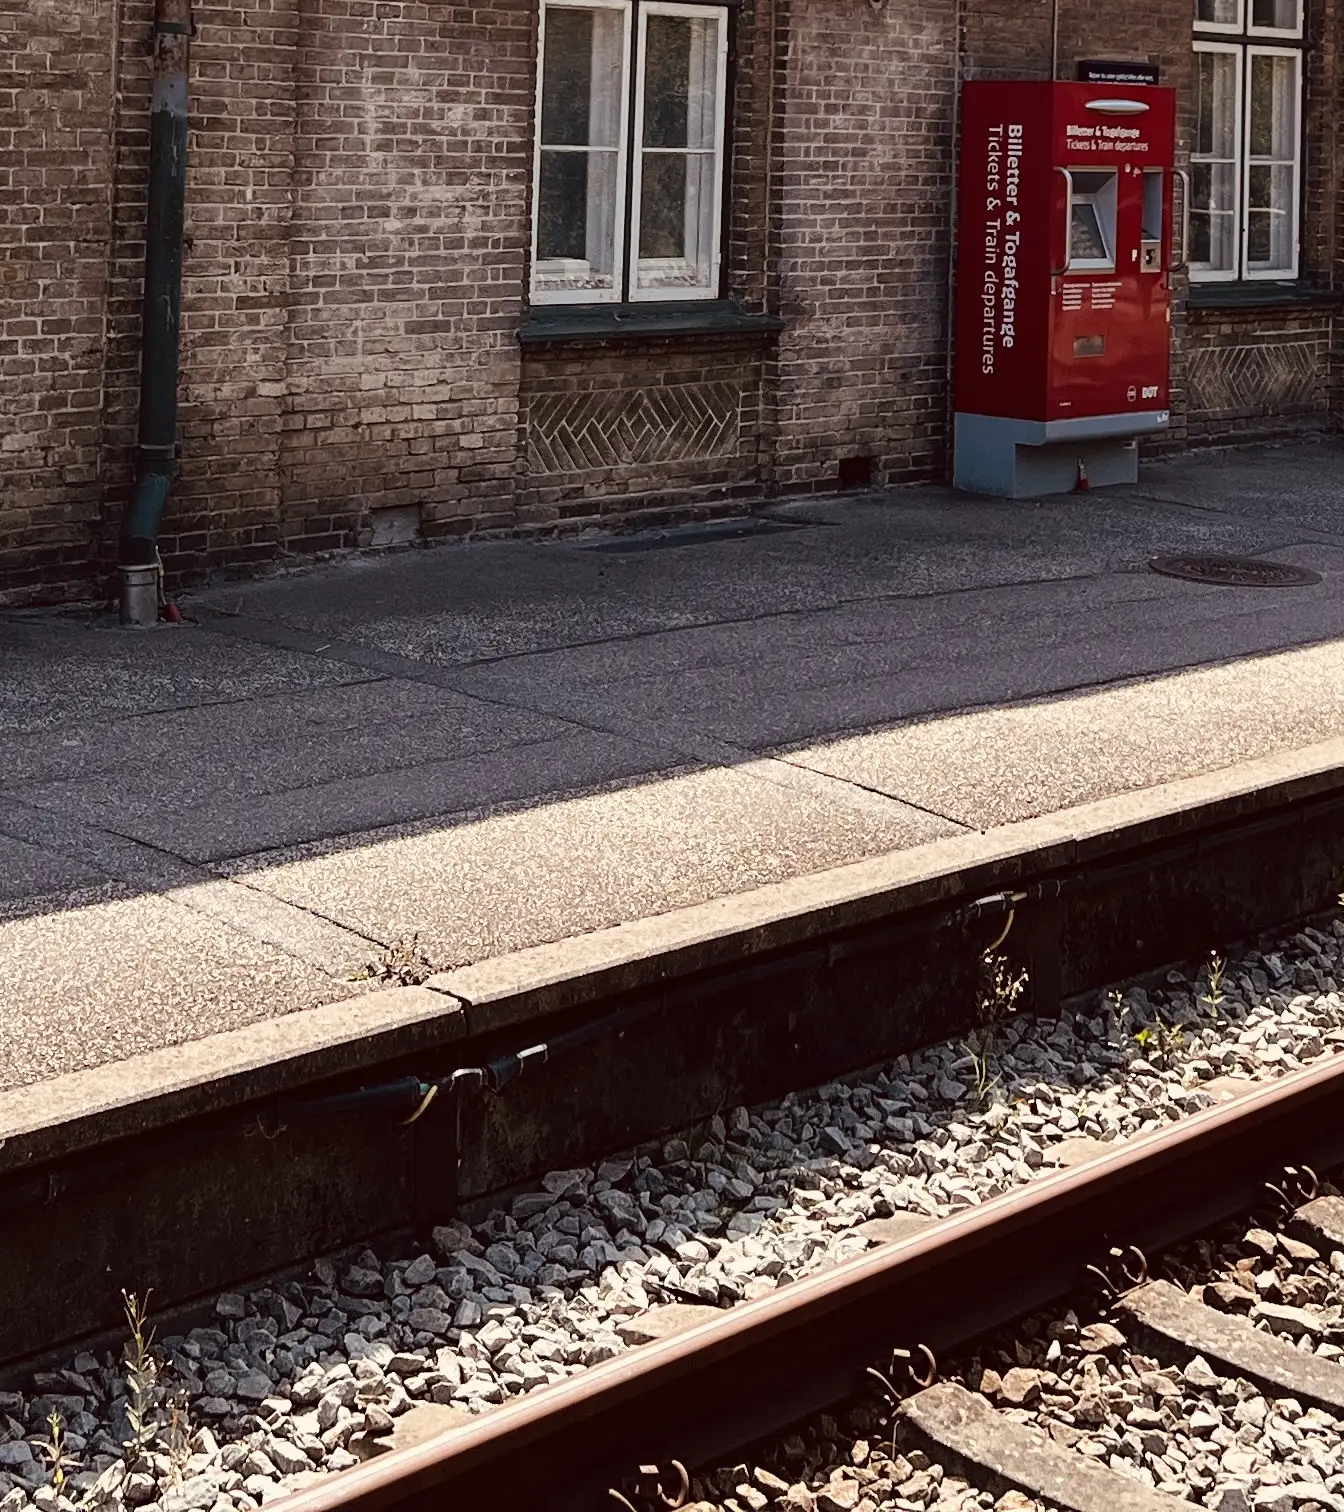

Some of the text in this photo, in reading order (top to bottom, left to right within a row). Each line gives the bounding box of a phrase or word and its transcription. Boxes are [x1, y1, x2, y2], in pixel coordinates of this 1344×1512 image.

[981, 124, 1003, 374] Tickets & Train departures
[1000, 125, 1023, 348] Billetter & Togafgange
